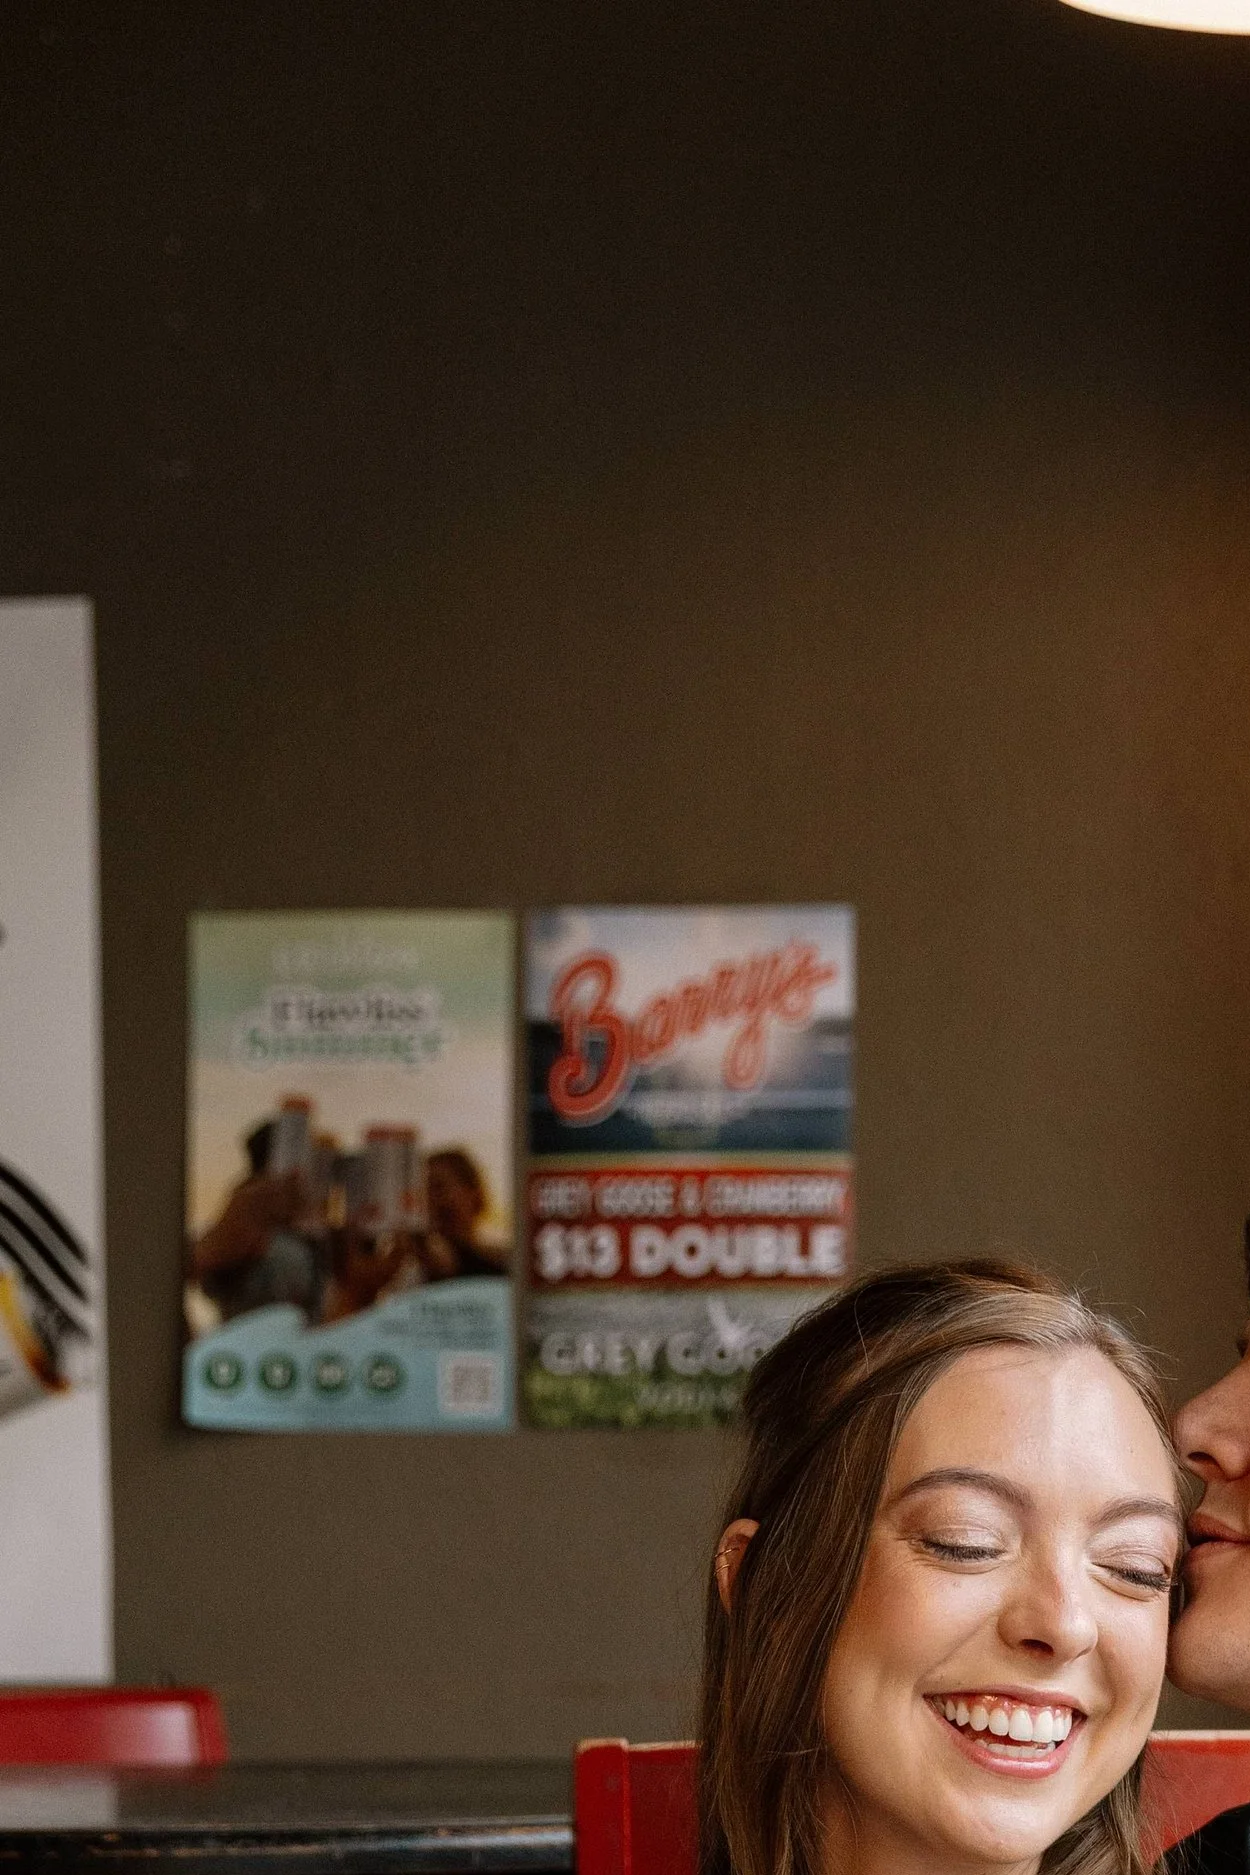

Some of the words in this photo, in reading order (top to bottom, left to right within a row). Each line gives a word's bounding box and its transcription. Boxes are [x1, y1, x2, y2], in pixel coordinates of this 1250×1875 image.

[537, 1226, 620, 1278] $13
[630, 1227, 844, 1276] DOUBLE
[542, 1334, 660, 1374] GREY
